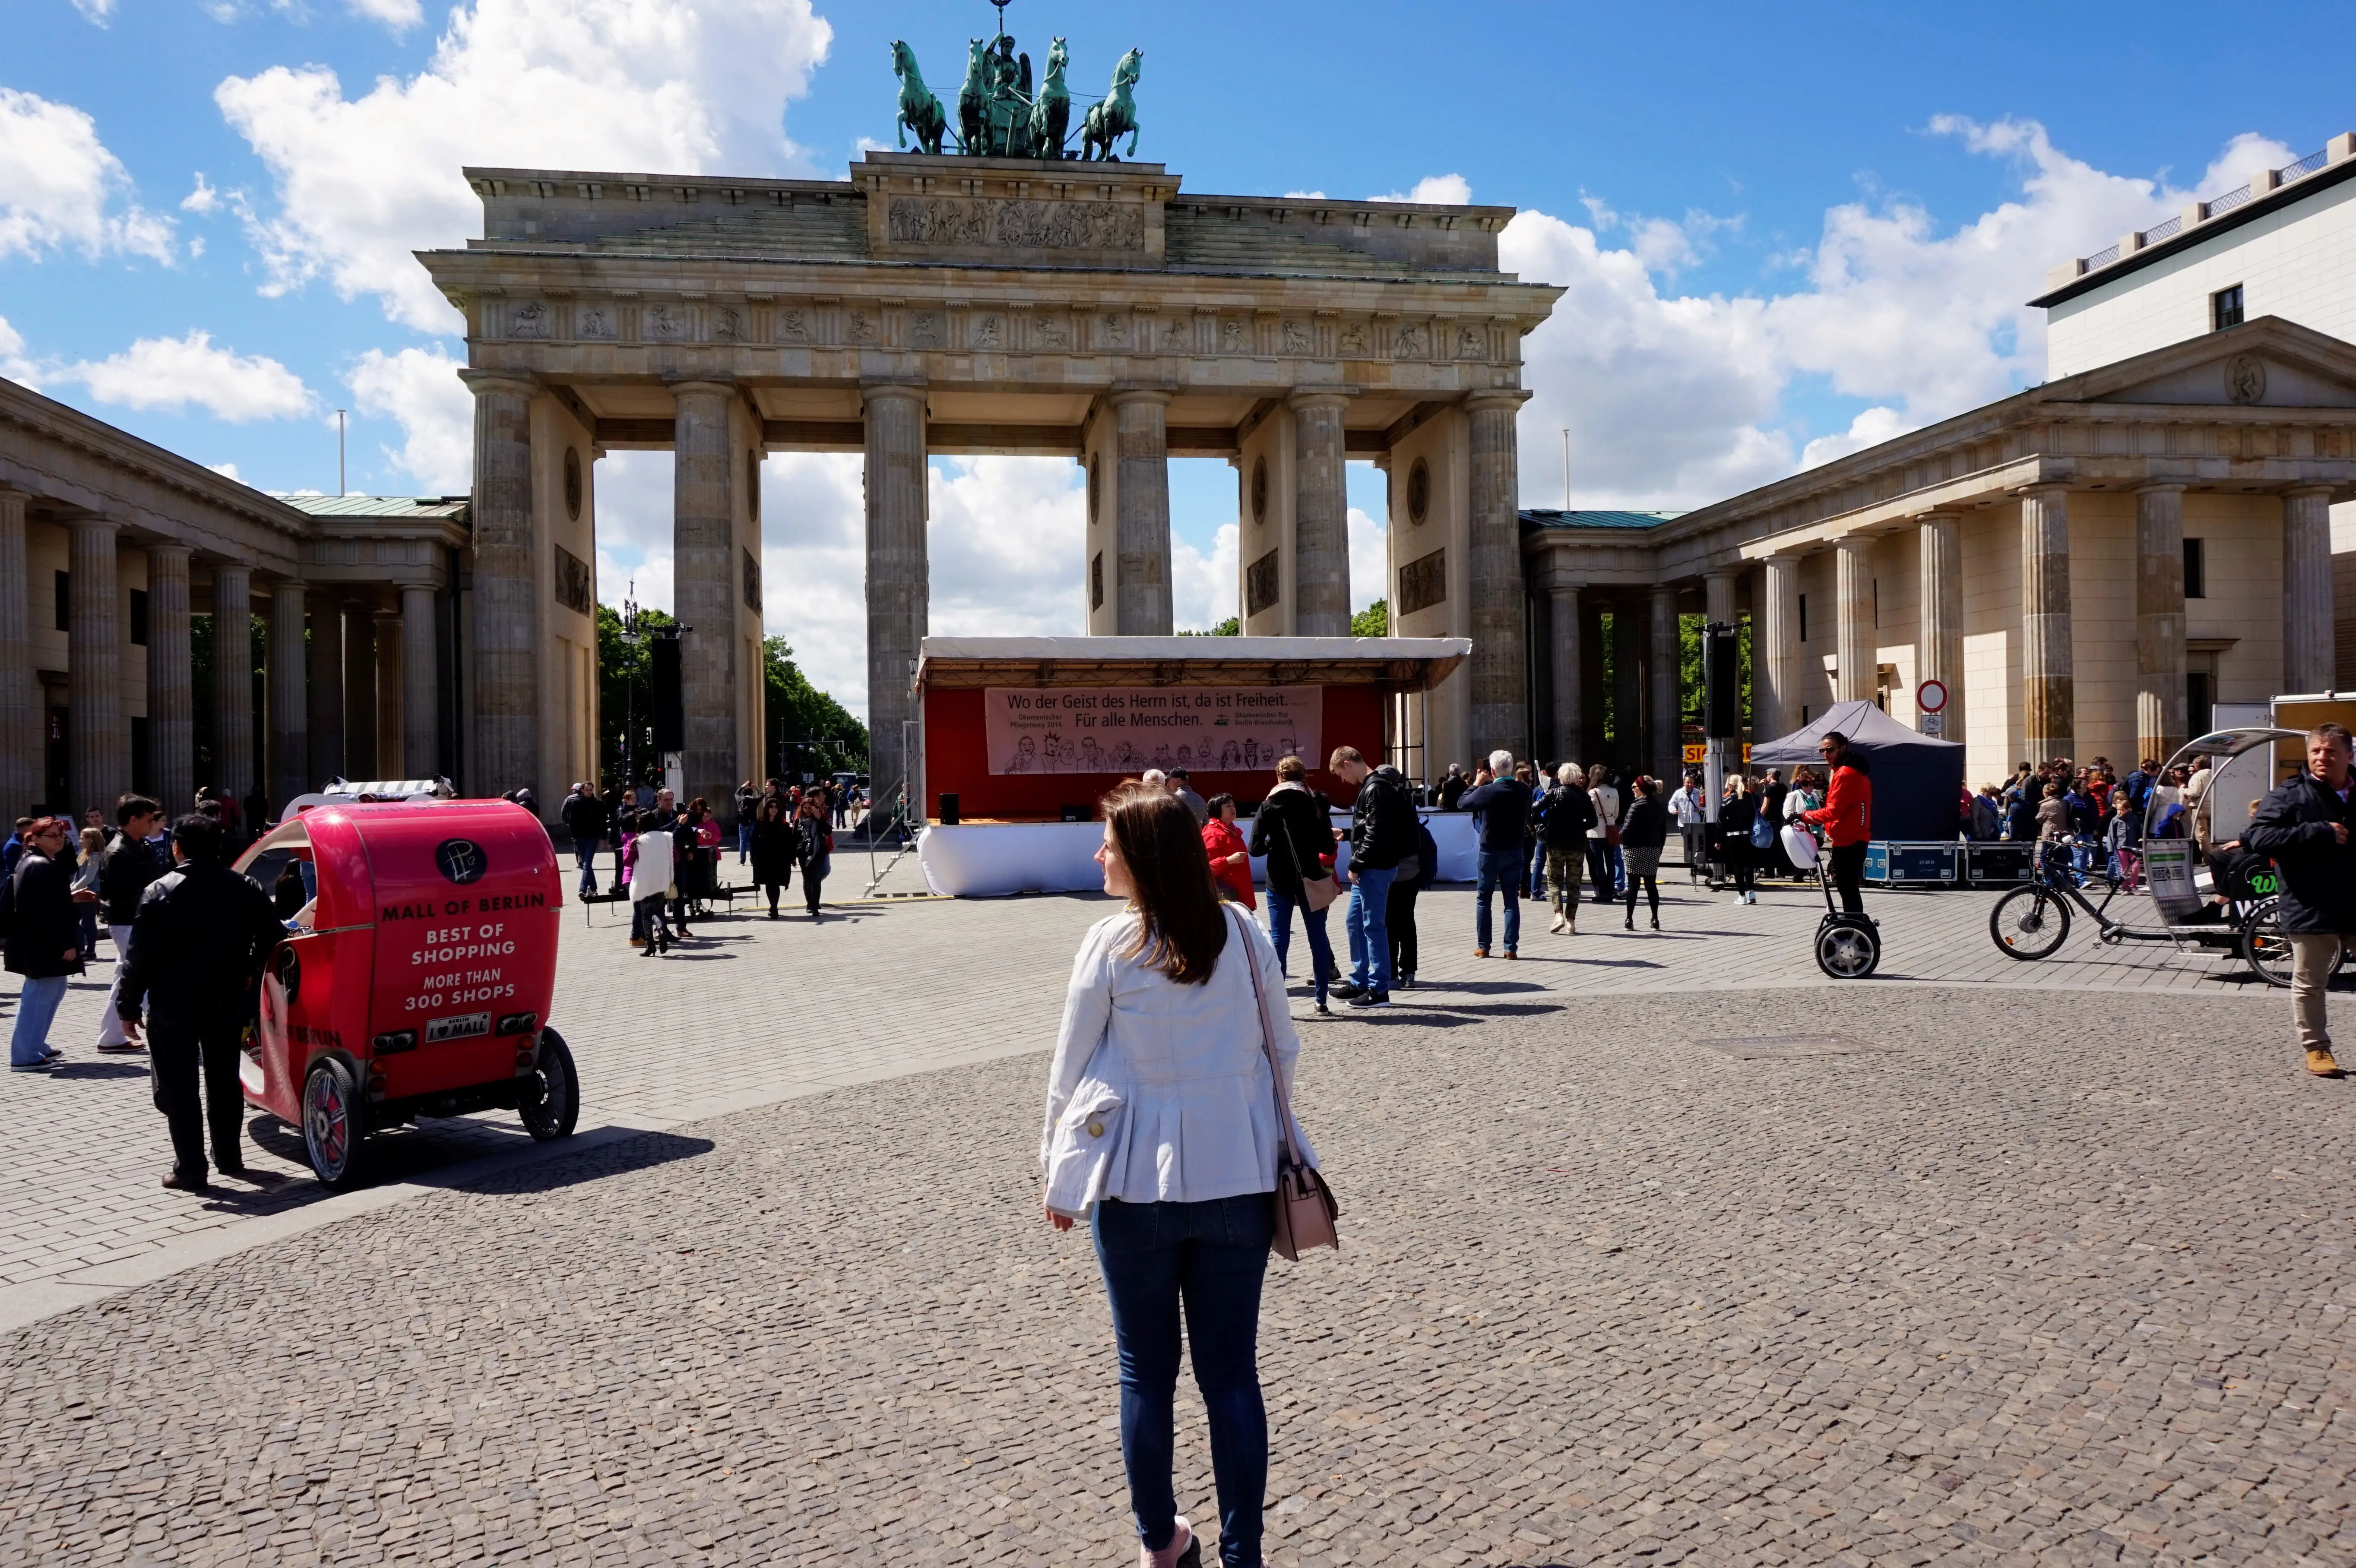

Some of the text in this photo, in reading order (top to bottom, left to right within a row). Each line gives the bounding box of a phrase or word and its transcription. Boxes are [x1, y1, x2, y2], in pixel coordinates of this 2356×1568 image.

[1007, 692, 1288, 709] Wo der Geist des Herrn ist, da ist Freiheit.
[1076, 712, 1203, 727] Für alle Menschen.
[382, 893, 544, 922] MALL OF BERLIN
[427, 923, 504, 944] BEST OF
[411, 941, 515, 965] SHOPPING
[423, 968, 500, 989] MORE THAN
[405, 983, 514, 1010] 300 SHOPS
[451, 1020, 484, 1036] MALL
